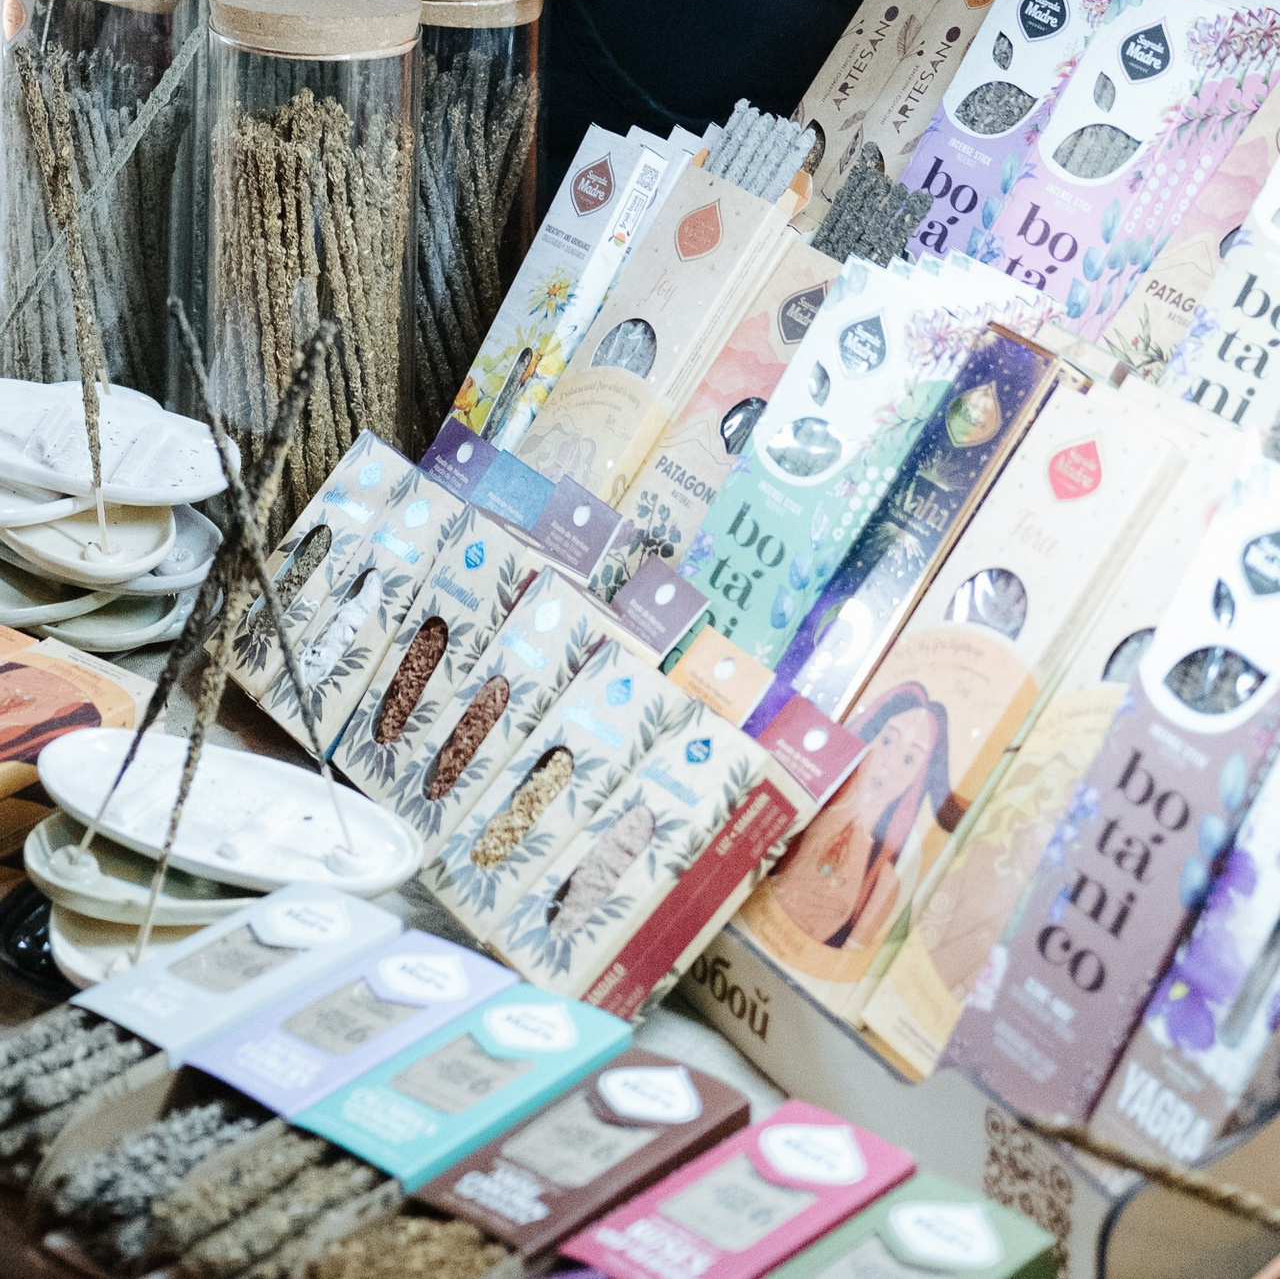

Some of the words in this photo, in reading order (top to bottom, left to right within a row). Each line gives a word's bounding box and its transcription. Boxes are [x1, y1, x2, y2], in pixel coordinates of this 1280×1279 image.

[1023, 3, 1060, 29] Madre
[1135, 33, 1164, 55] Sagrada
[832, 5, 900, 112] ARTESANO
[891, 26, 962, 134] ARTESANO
[1124, 43, 1162, 71] Madre
[920, 155, 979, 215] bo
[973, 149, 993, 167] STICK
[577, 177, 605, 202] Madre
[1016, 201, 1080, 265] bo
[785, 302, 815, 327] Madr
[1144, 279, 1197, 314] PATAG
[1217, 327, 1280, 381] tá
[1190, 374, 1257, 428] ni
[655, 455, 718, 503] PATAGON
[725, 502, 786, 570] bo
[708, 556, 763, 612] tá
[1115, 749, 1191, 833] bo
[1096, 816, 1166, 884] tá
[1067, 867, 1136, 939] ni
[1035, 925, 1108, 995] co
[690, 954, 771, 1043] обой
[1118, 1062, 1215, 1163] YAGRA
